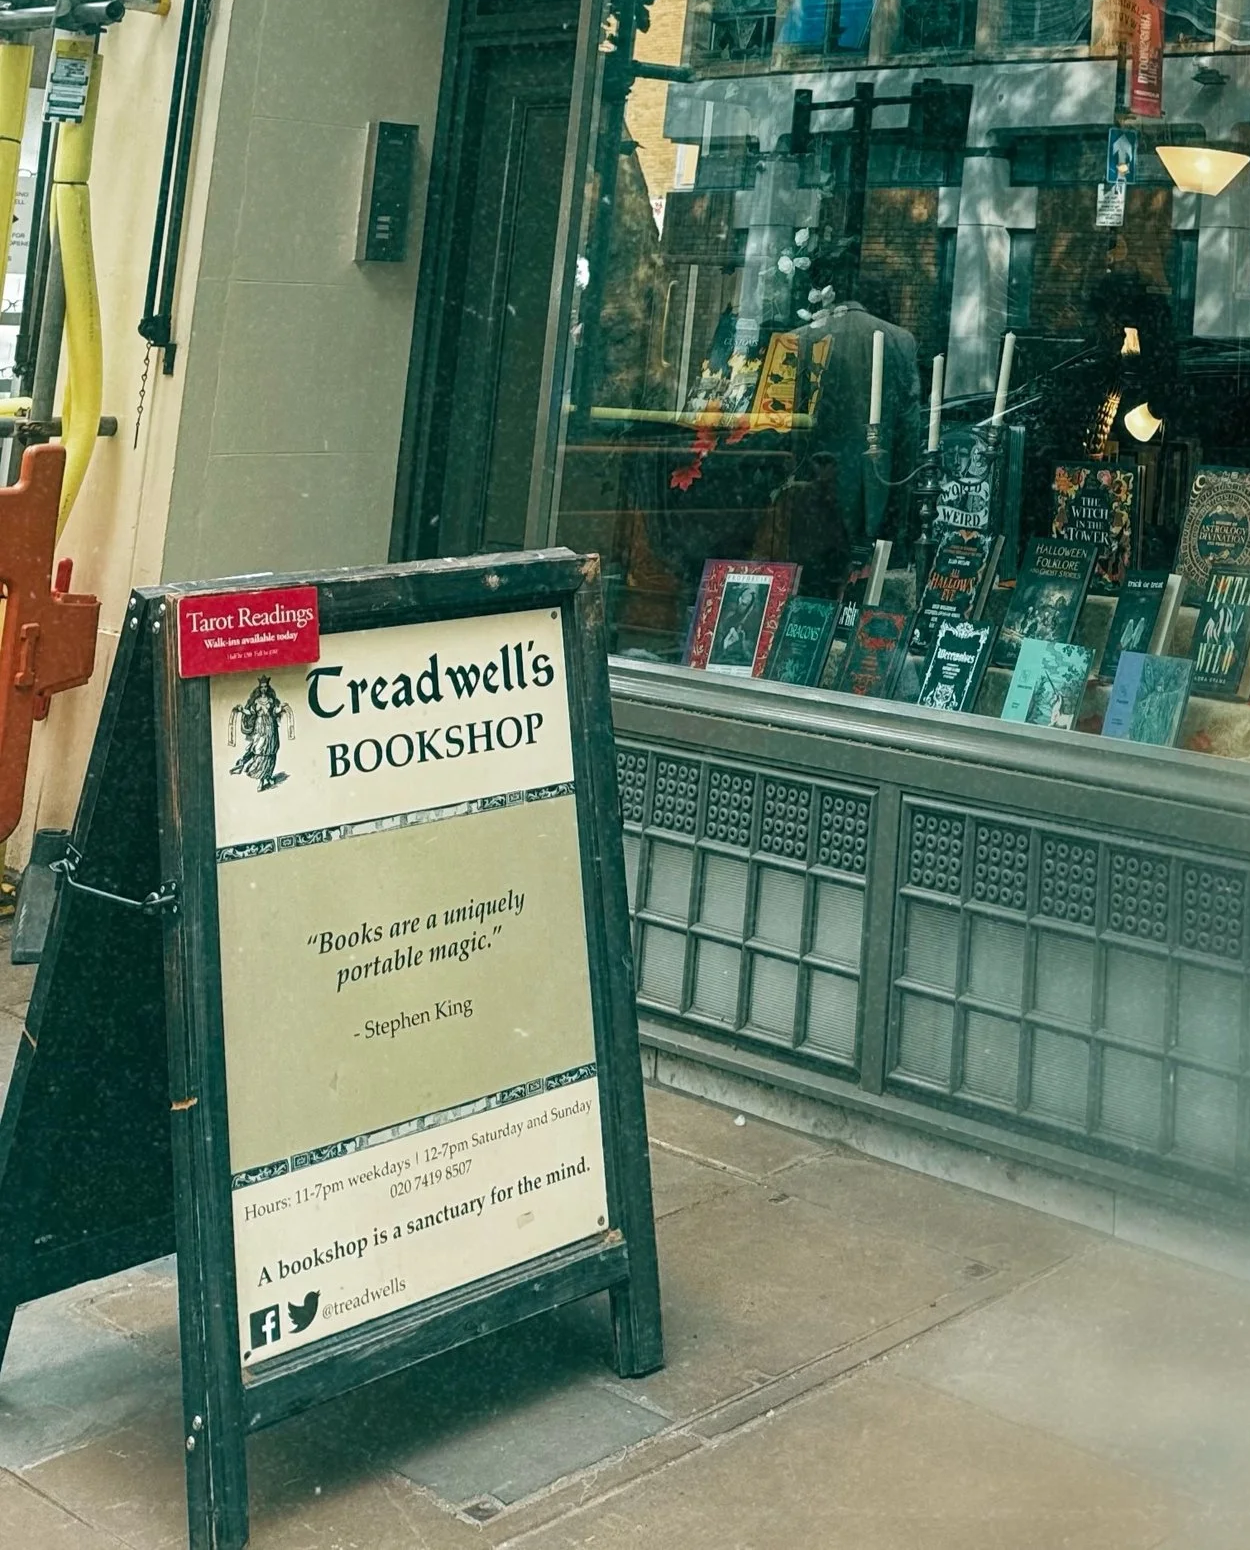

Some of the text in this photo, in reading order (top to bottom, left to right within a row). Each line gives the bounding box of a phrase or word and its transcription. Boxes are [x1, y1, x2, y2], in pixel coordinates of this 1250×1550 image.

[1071, 505, 1109, 520] WITCH
[1081, 496, 1101, 507] THE
[942, 508, 981, 527] WEIRD
[1076, 519, 1086, 529] IN
[1067, 526, 1110, 546] TOWER
[1035, 543, 1088, 560] HALLOWEEN
[1036, 556, 1080, 572] FOLKLORE
[1127, 580, 1143, 588] trick
[1150, 581, 1164, 589] treat
[186, 603, 315, 633] Tarot Readings
[204, 631, 299, 650] Walk-ins available today
[785, 623, 821, 641] DRAGONS
[306, 640, 555, 719] Treadwell's
[326, 712, 544, 778] BOOKSHOP
[389, 916, 420, 939] are
[426, 912, 438, 930] a
[443, 888, 526, 925] uniquely
[336, 945, 424, 993] portable
[364, 1010, 431, 1040] Stephen
[434, 999, 474, 1021] King
[244, 1196, 292, 1222] Hours:
[295, 1179, 345, 1205] 11-7pm
[348, 1157, 412, 1188] weekdays
[424, 1138, 469, 1164] 12-7pm
[471, 1120, 524, 1148] Saturday
[526, 1110, 548, 1130] and
[550, 1099, 593, 1123] Sunday
[389, 1159, 473, 1199] 020 7419 8507
[257, 1155, 591, 1288] A bookshop is a sanctuary for the mind.
[322, 1277, 407, 1320] @treadwells
